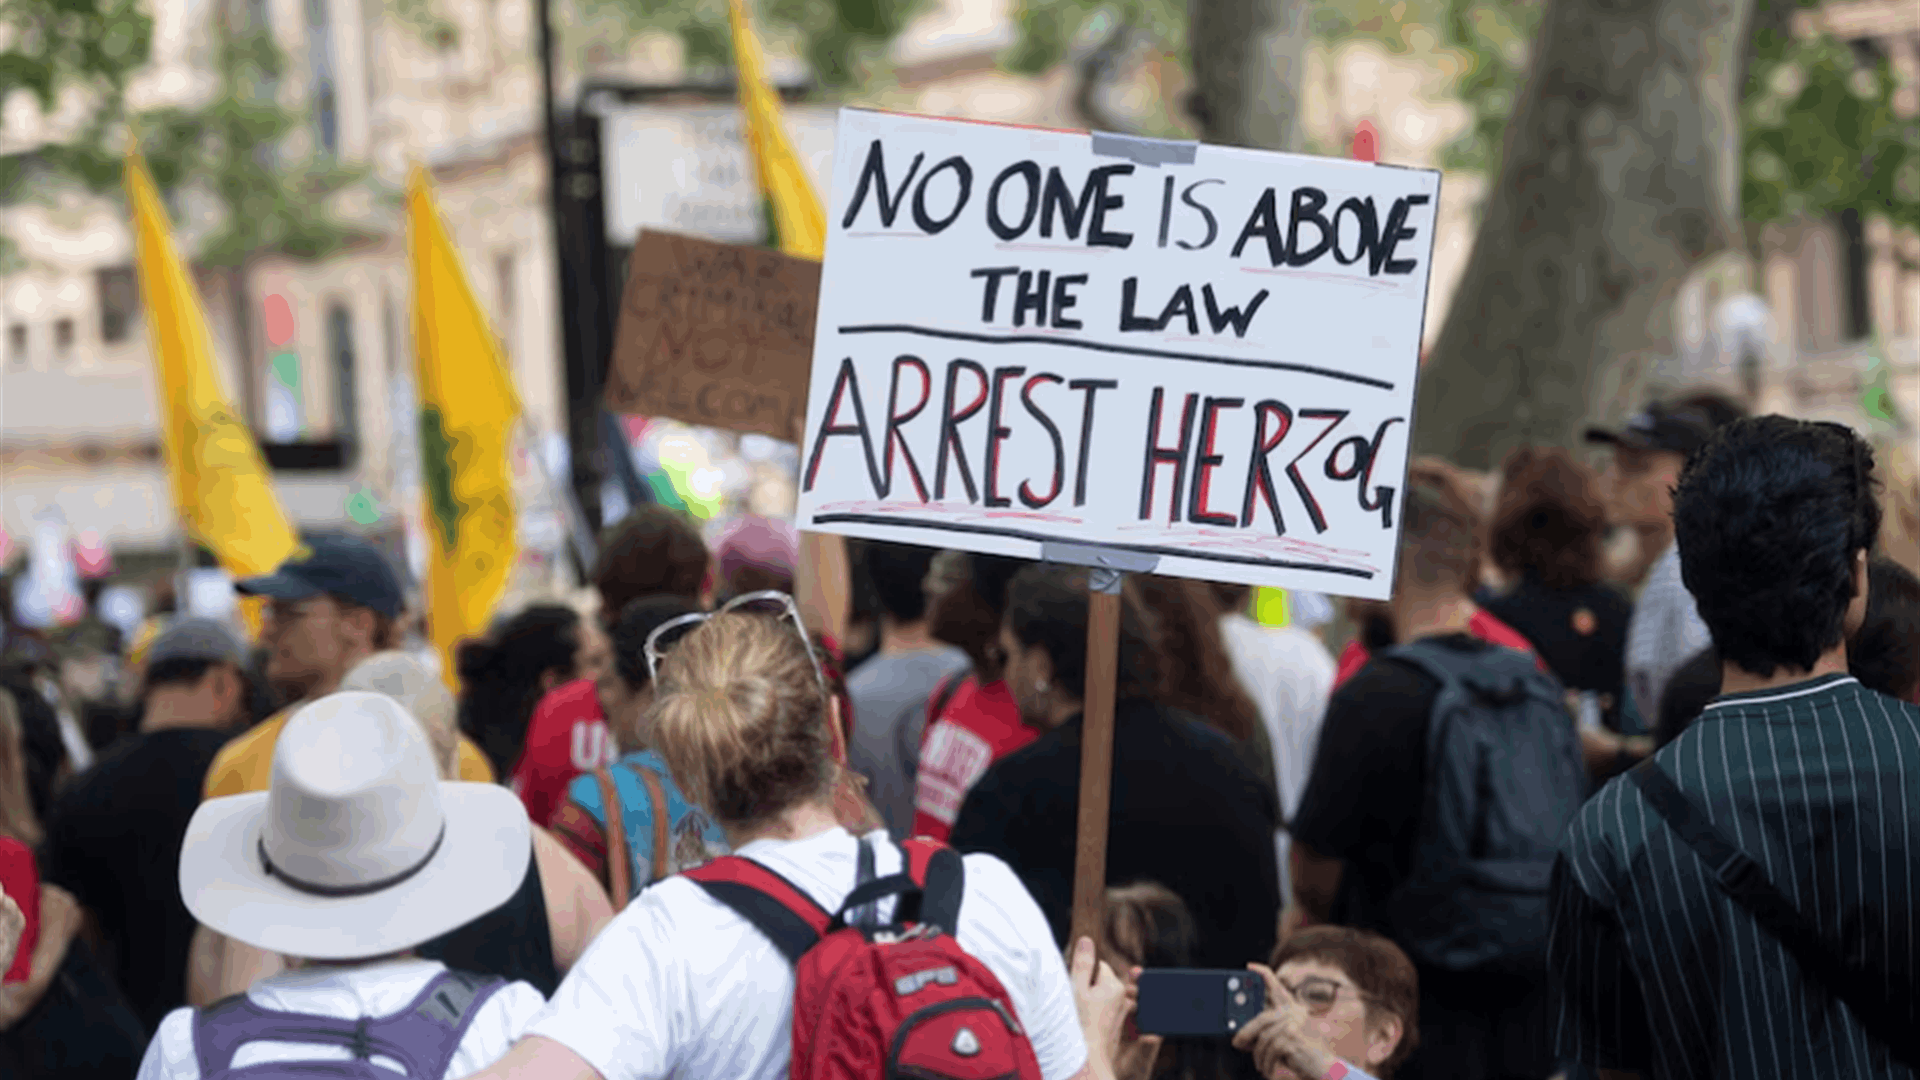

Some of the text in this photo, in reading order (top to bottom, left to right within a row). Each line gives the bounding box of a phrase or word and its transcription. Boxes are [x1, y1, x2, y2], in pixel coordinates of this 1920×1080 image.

[843, 140, 973, 235] NO
[987, 160, 1135, 249] ONE
[1158, 174, 1226, 250] IS
[1231, 187, 1429, 276] ABOVE
[971, 267, 1269, 337] THE LAW
[804, 355, 1405, 536] ARREST HERZOG
